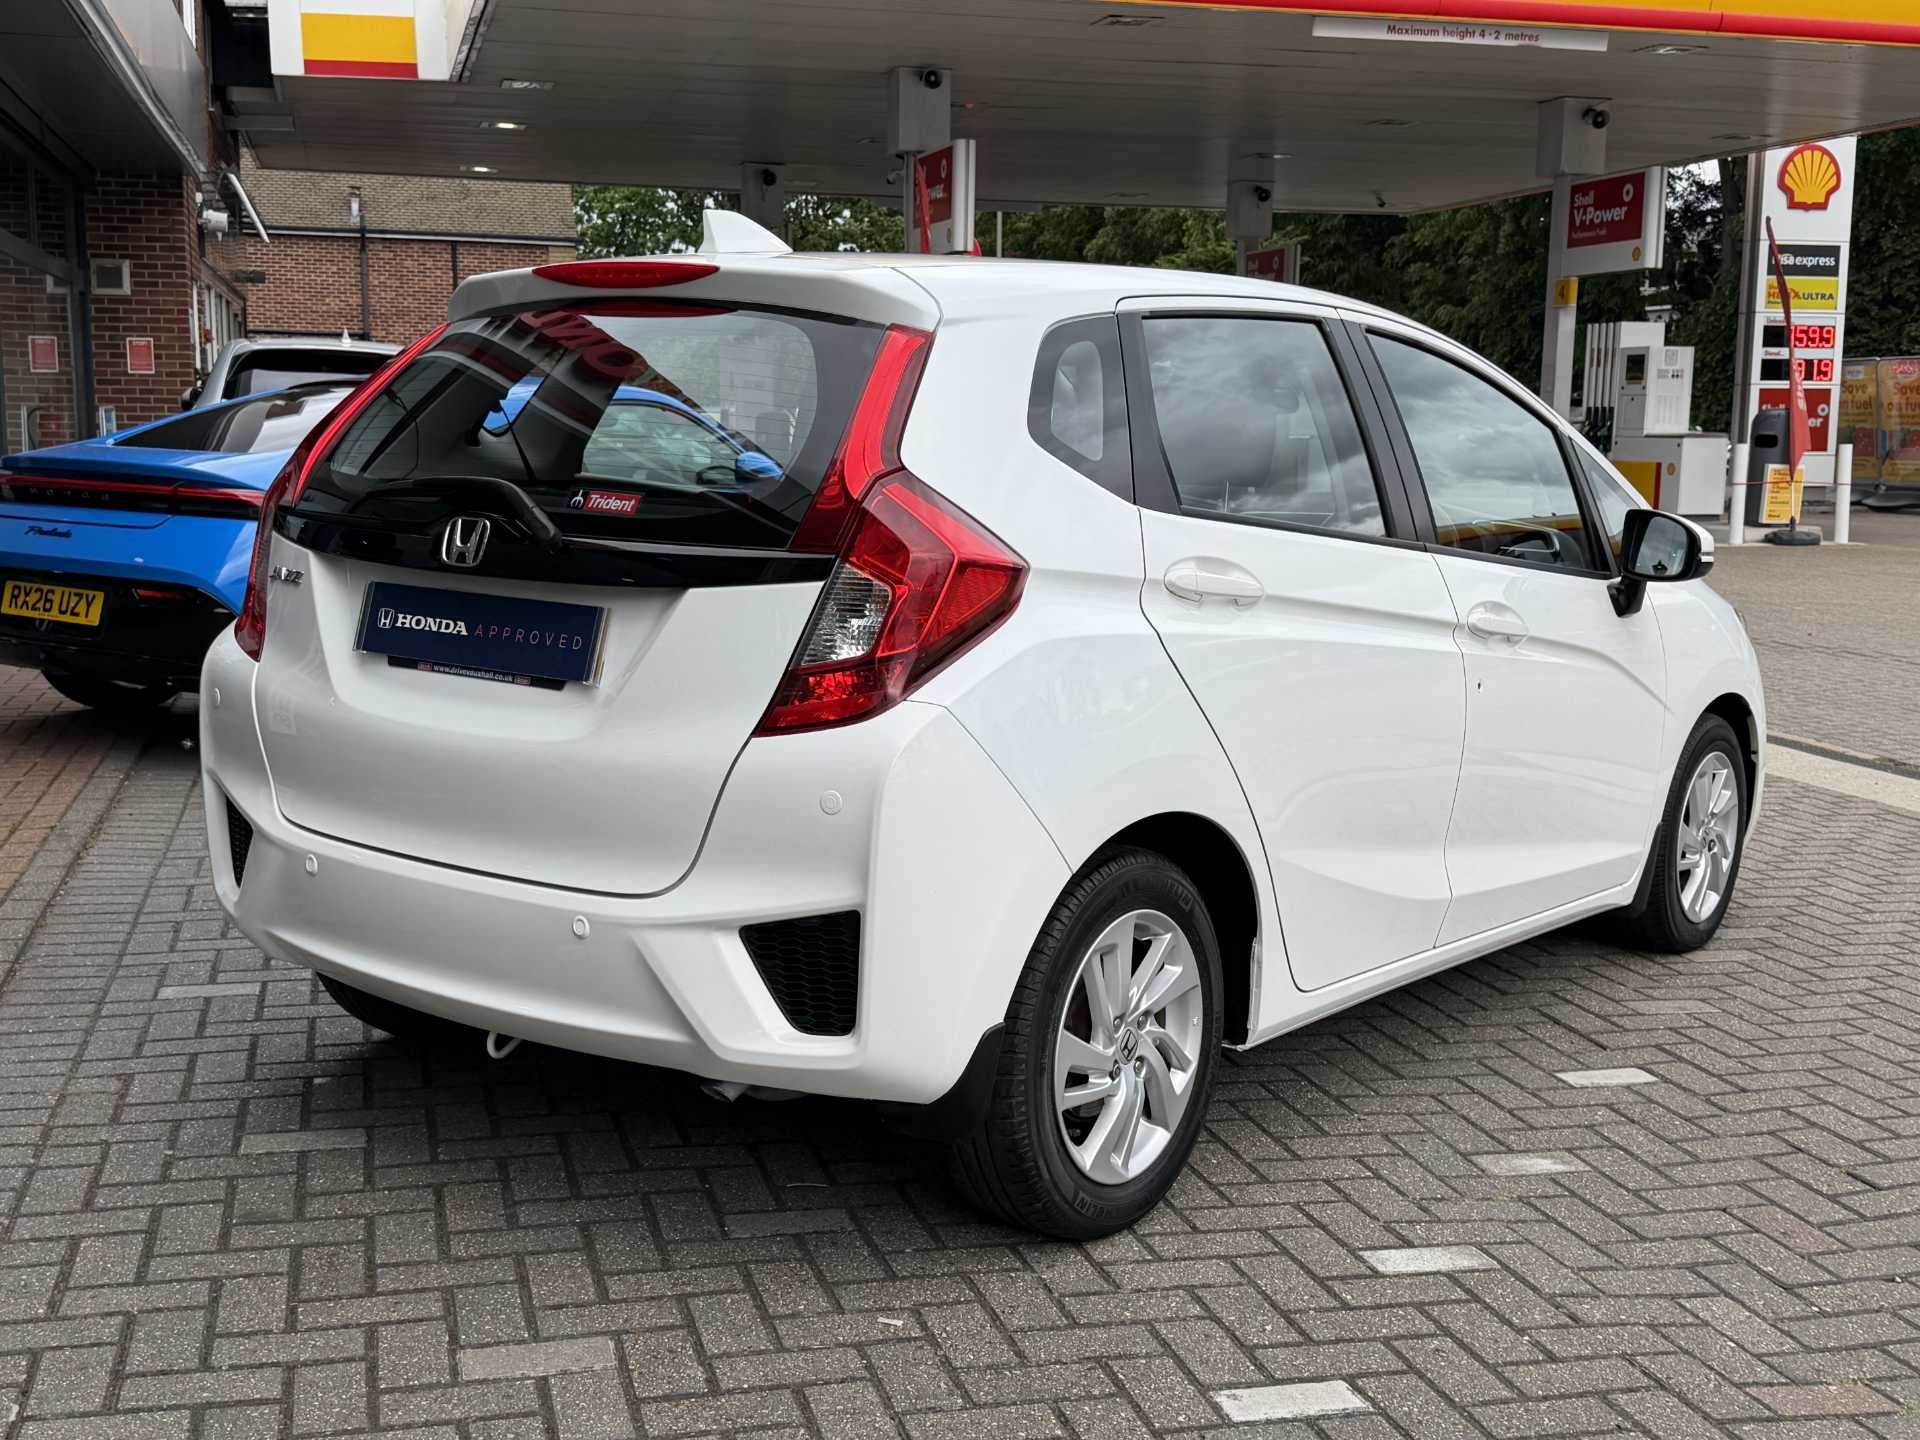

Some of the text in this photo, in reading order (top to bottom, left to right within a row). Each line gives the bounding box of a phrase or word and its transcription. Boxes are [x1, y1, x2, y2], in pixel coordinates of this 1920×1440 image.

[1386, 24, 1439, 37] Maximum
[1443, 26, 1476, 40] height
[1504, 32, 1540, 42] metres
[1574, 190, 1594, 206] Shell
[1795, 256, 1836, 267] express
[1802, 292, 1834, 301] ULTRA
[1790, 325, 1835, 348] 159.9
[588, 494, 636, 512] Trident
[9, 585, 96, 618] RX26 UZY
[396, 613, 583, 650] HONDA APPROVED
